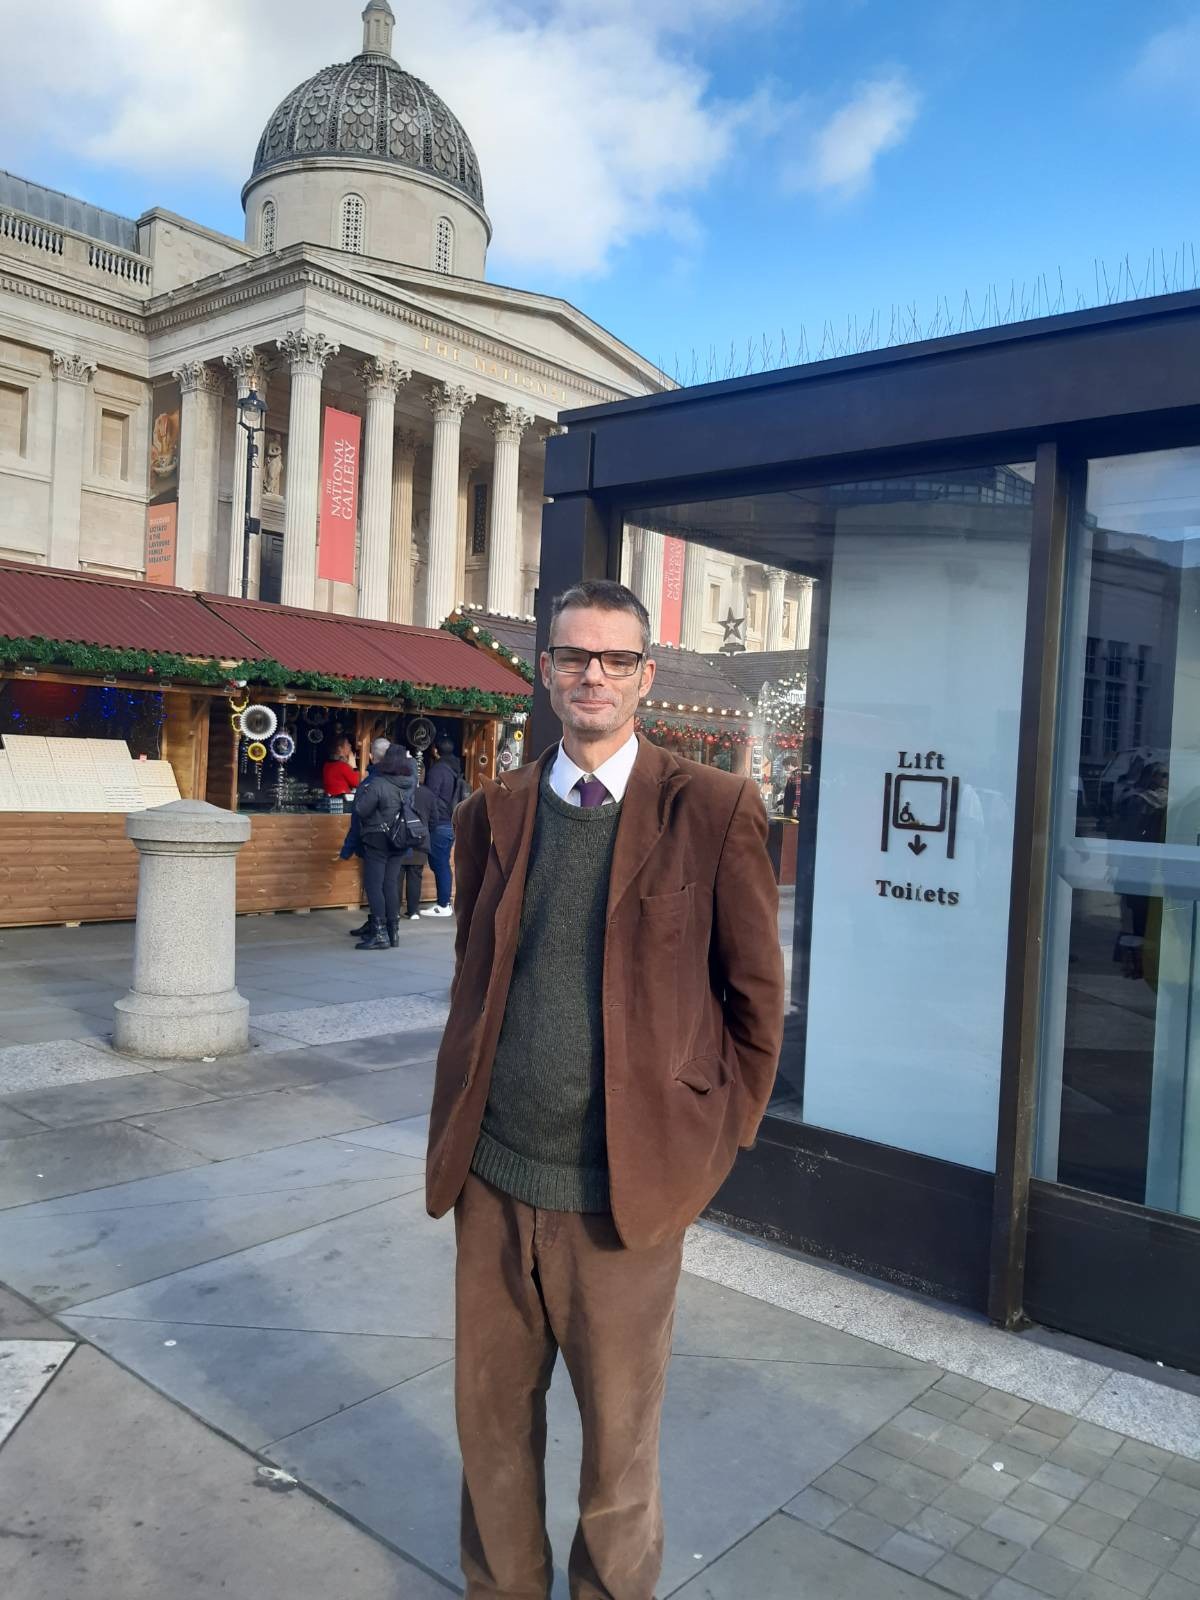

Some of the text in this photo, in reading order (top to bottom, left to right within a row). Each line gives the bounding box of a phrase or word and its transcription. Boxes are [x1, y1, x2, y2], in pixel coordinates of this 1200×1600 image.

[423, 335, 569, 403] THE NATIONAL
[331, 438, 344, 517] NATIONAL
[341, 440, 356, 520] GALLERY
[897, 751, 945, 770] Lift
[875, 880, 960, 906] Toilets
